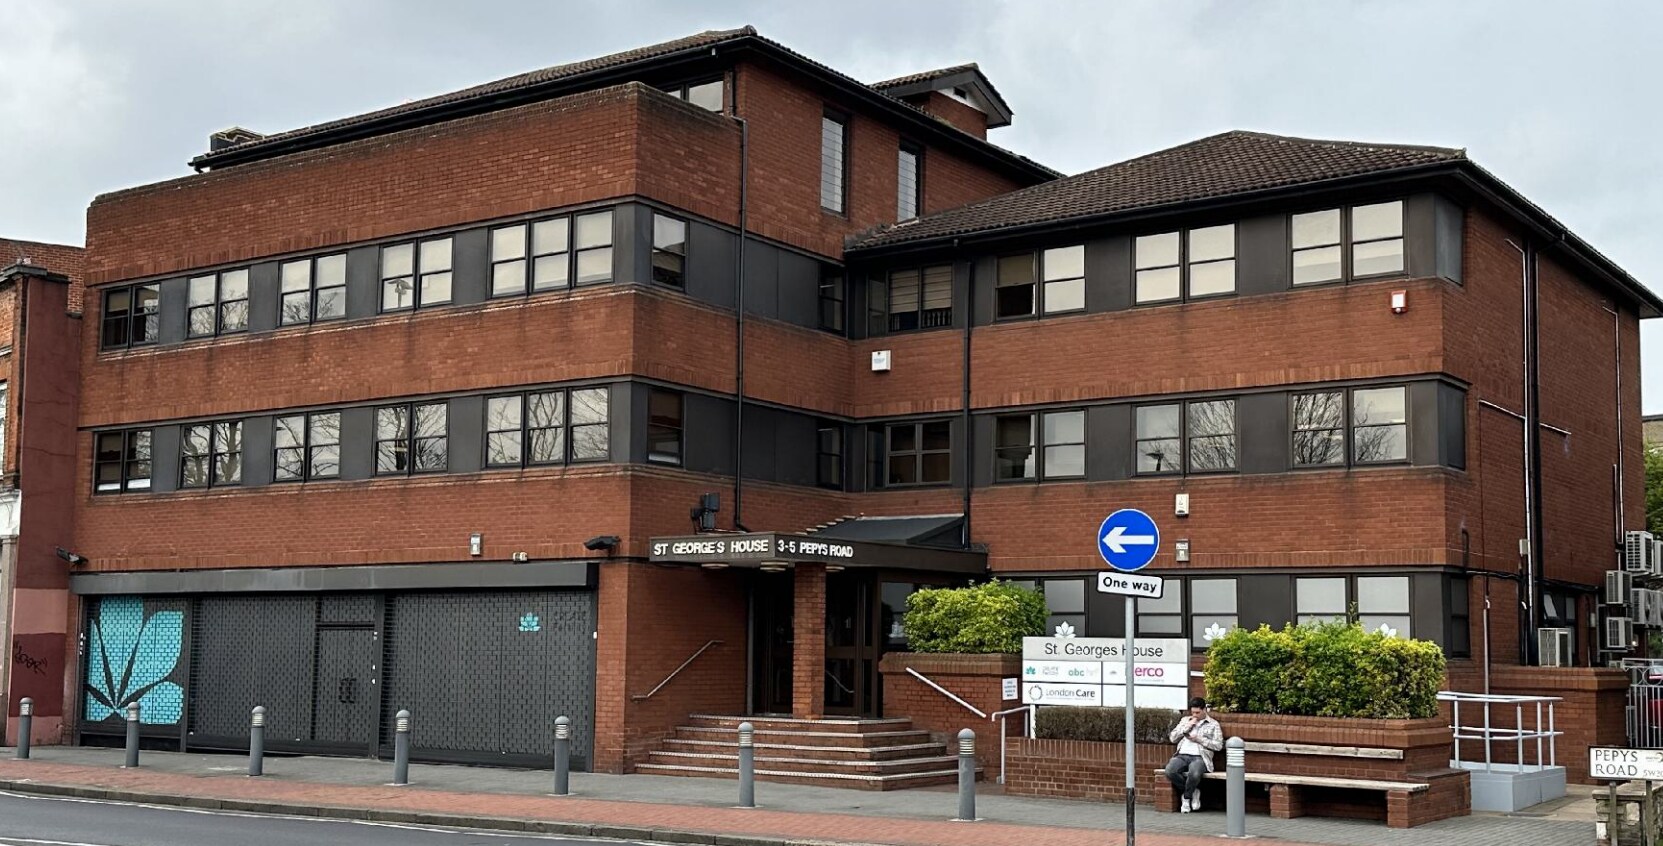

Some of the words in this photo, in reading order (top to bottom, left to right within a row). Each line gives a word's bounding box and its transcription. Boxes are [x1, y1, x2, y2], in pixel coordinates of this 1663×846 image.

[654, 543, 668, 555] ST
[672, 541, 725, 554] GEORGE'S
[731, 540, 768, 552] HOUSE
[778, 540, 796, 553] 3-5
[799, 542, 828, 555] PEPYS
[829, 544, 854, 557] ROAD
[1103, 576, 1128, 588] One
[1132, 582, 1157, 593] way
[1044, 642, 1061, 655] St.
[1064, 643, 1118, 658] Georges
[1046, 689, 1075, 697] London
[1075, 689, 1096, 698] Care
[1595, 749, 1638, 762] PEPYS
[1595, 763, 1638, 776] ROAD
